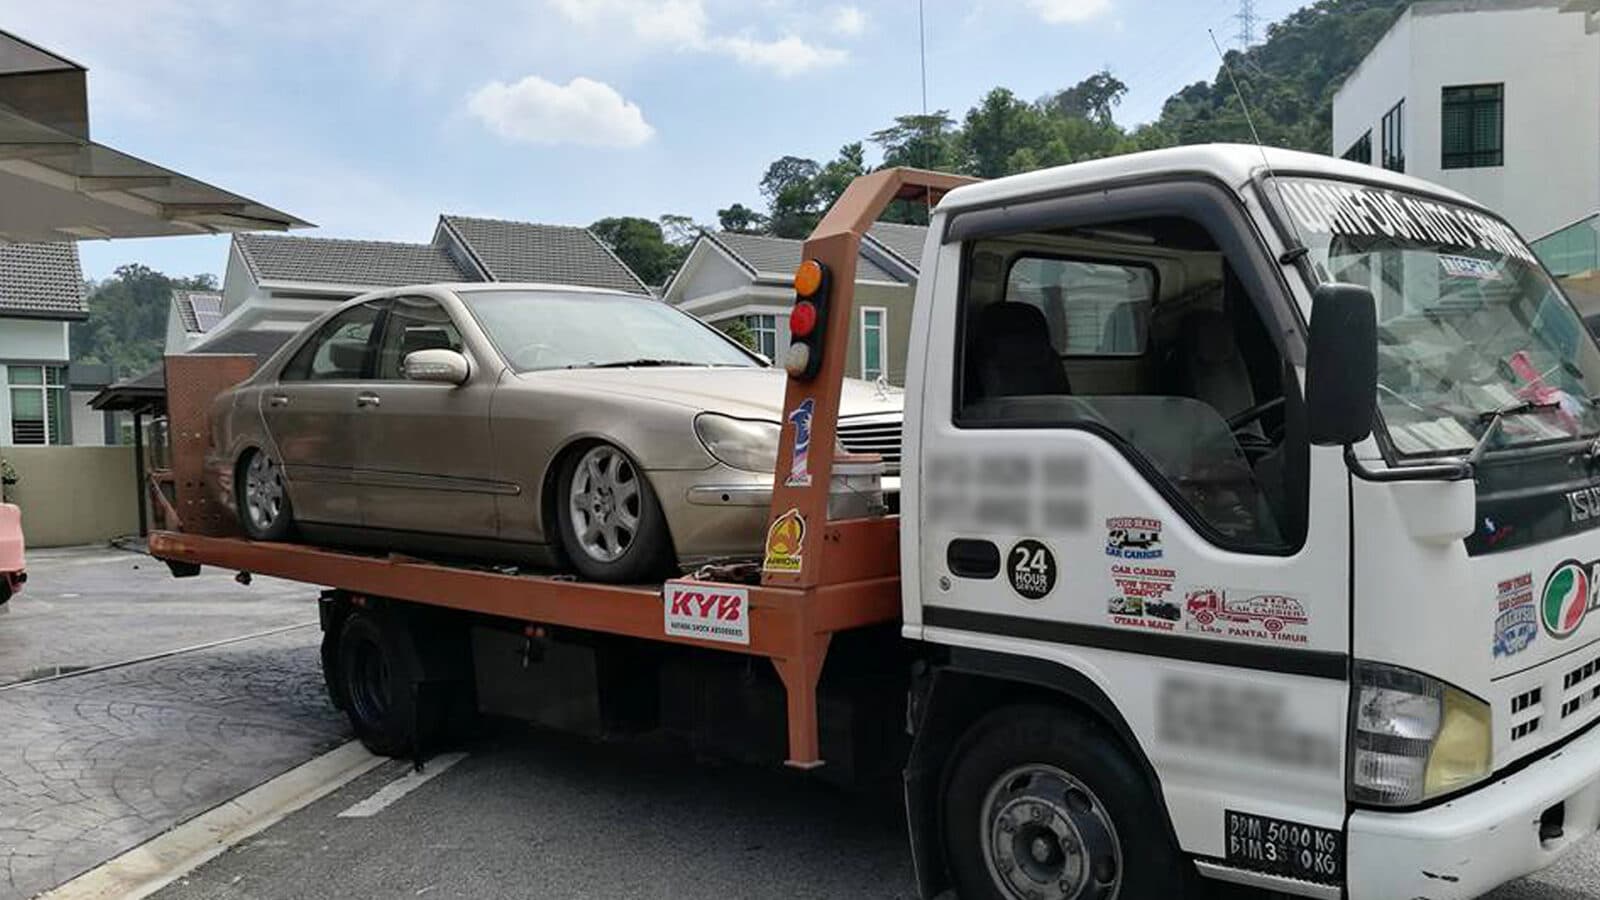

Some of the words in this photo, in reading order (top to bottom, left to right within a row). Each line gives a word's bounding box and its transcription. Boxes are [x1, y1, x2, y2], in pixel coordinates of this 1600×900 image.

[1279, 181, 1424, 239] WANFOUR
[1400, 196, 1475, 248] AUTO
[1016, 547, 1047, 573] 24
[1111, 565, 1132, 574] CAR
[1133, 567, 1176, 578] CARRIER
[1015, 571, 1047, 585] HOUR
[1114, 579, 1137, 589] TOW
[1139, 581, 1173, 591] TRUCK
[671, 591, 741, 621] KYB
[1228, 627, 1267, 639] PANTAI
[1271, 632, 1307, 642] TIMUR
[1267, 821, 1311, 848] 5000
[1314, 829, 1336, 853] KG
[1314, 852, 1336, 875] KG
